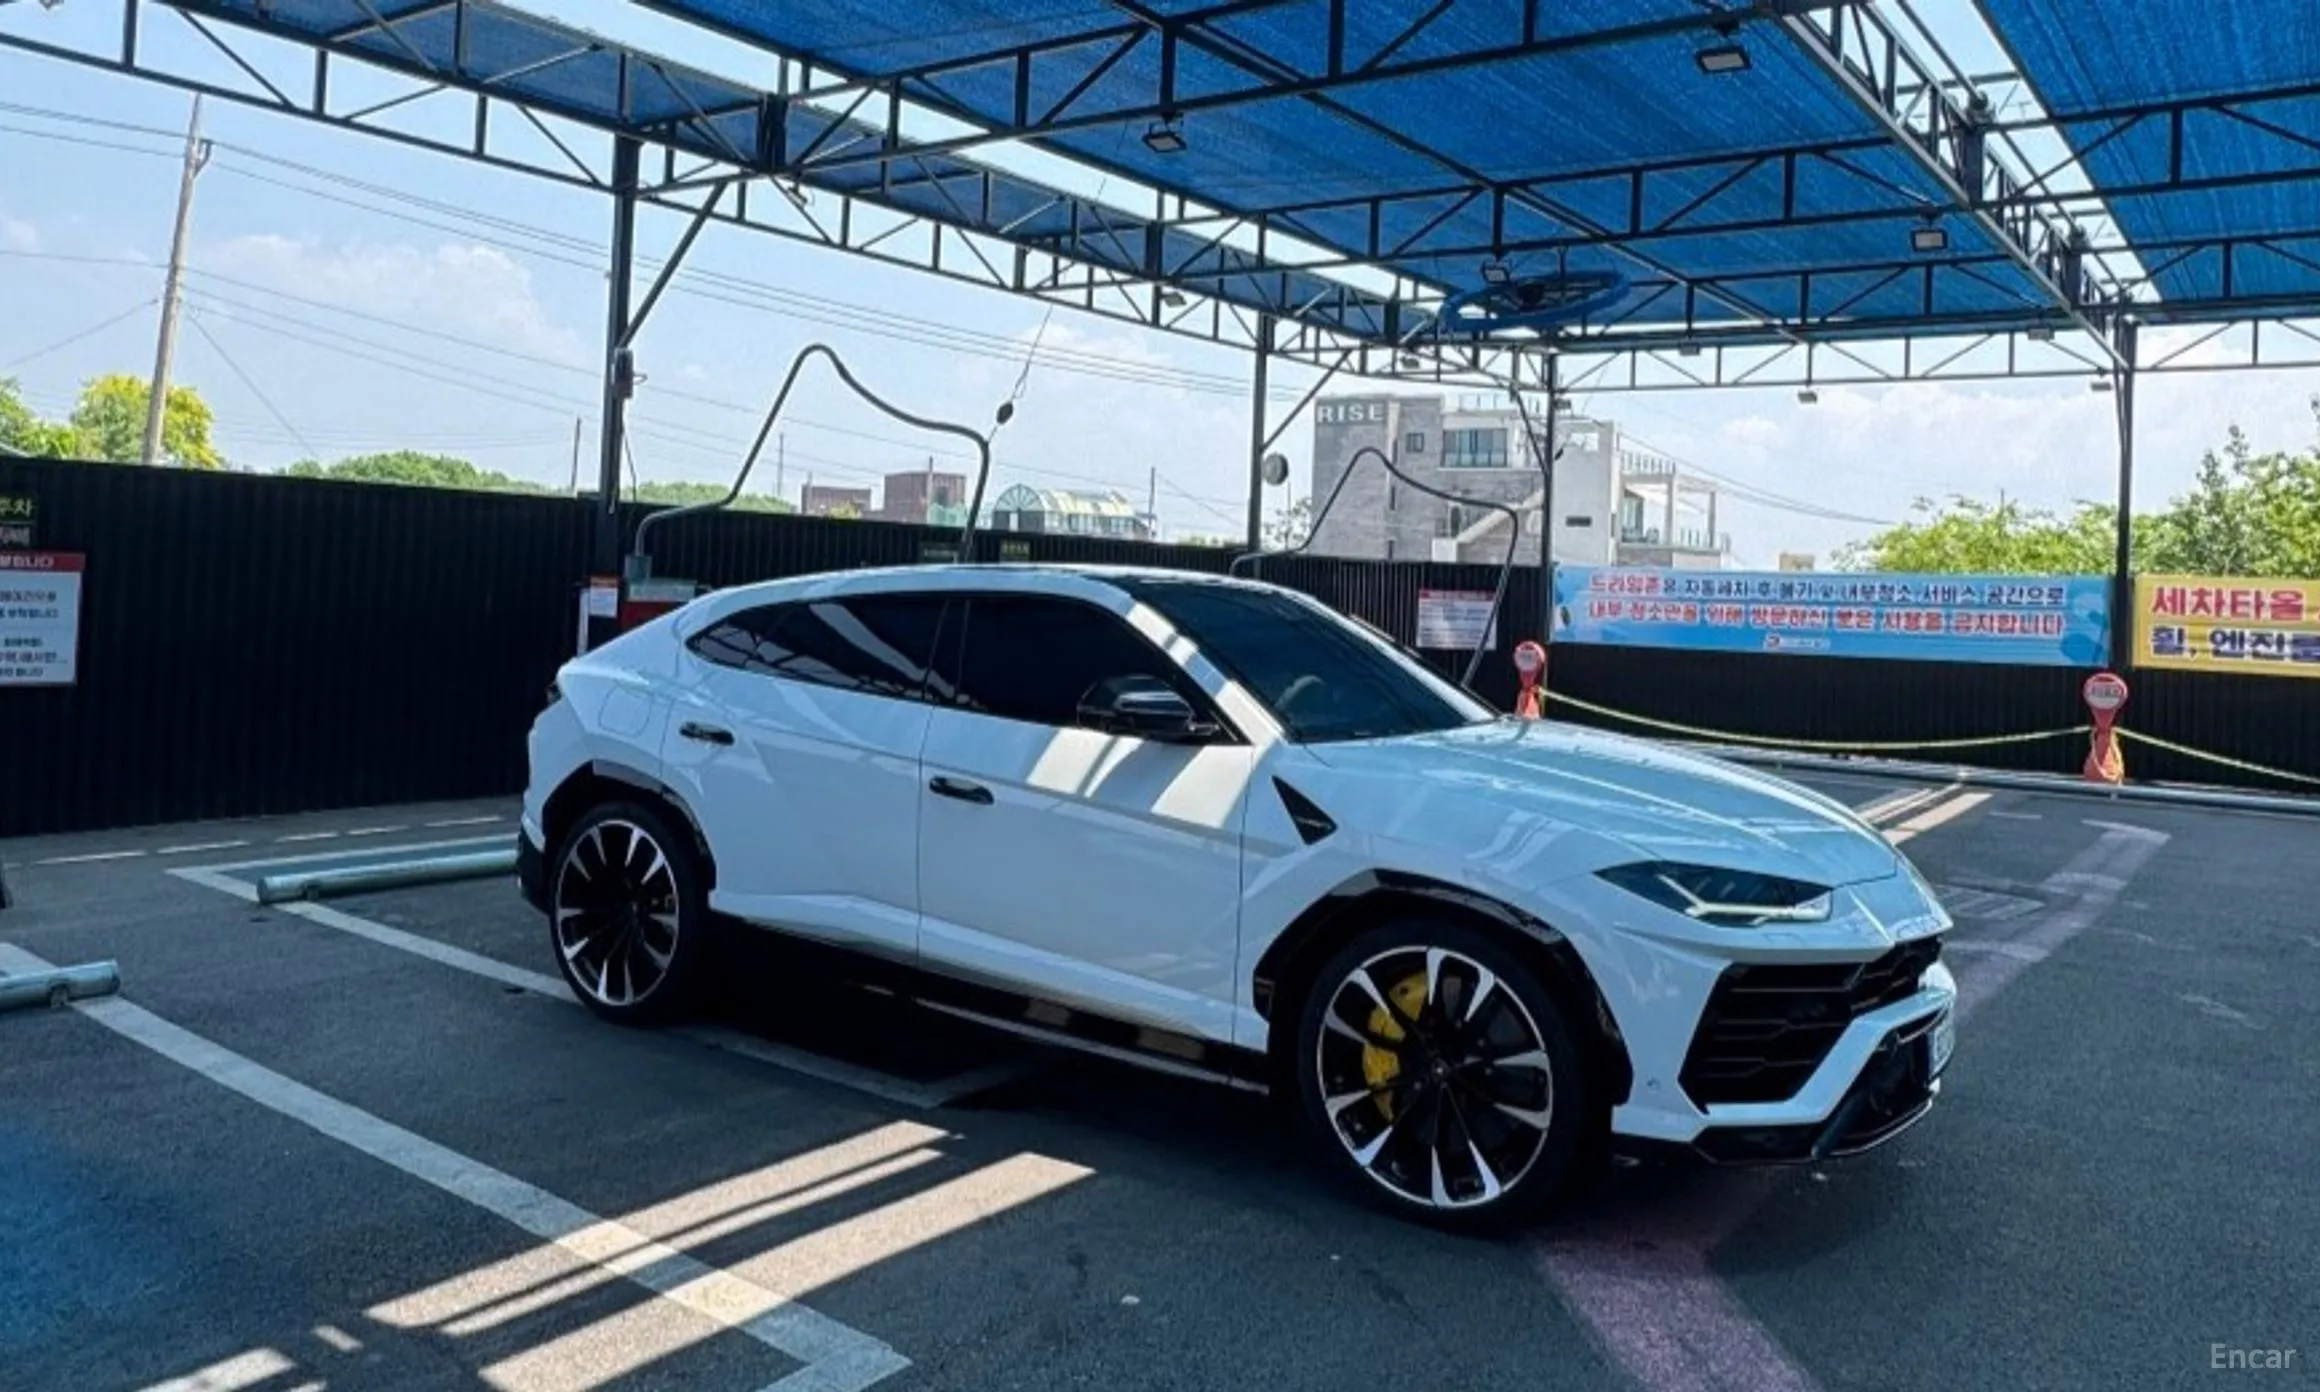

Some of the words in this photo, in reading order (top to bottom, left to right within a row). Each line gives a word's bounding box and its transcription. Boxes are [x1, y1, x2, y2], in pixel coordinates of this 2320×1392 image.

[1317, 403, 1383, 423] RISE
[1685, 579, 1749, 596] 자동세차
[1758, 580, 1772, 596] 후
[1924, 584, 1977, 602] 서비스
[1987, 585, 2064, 605] 공간으로
[1590, 601, 1622, 618] 내부
[1707, 604, 1742, 624] 위해
[1752, 606, 1826, 627] 방문하신
[1884, 610, 1944, 632] 사용을
[1955, 611, 2063, 635] 금지합니다
